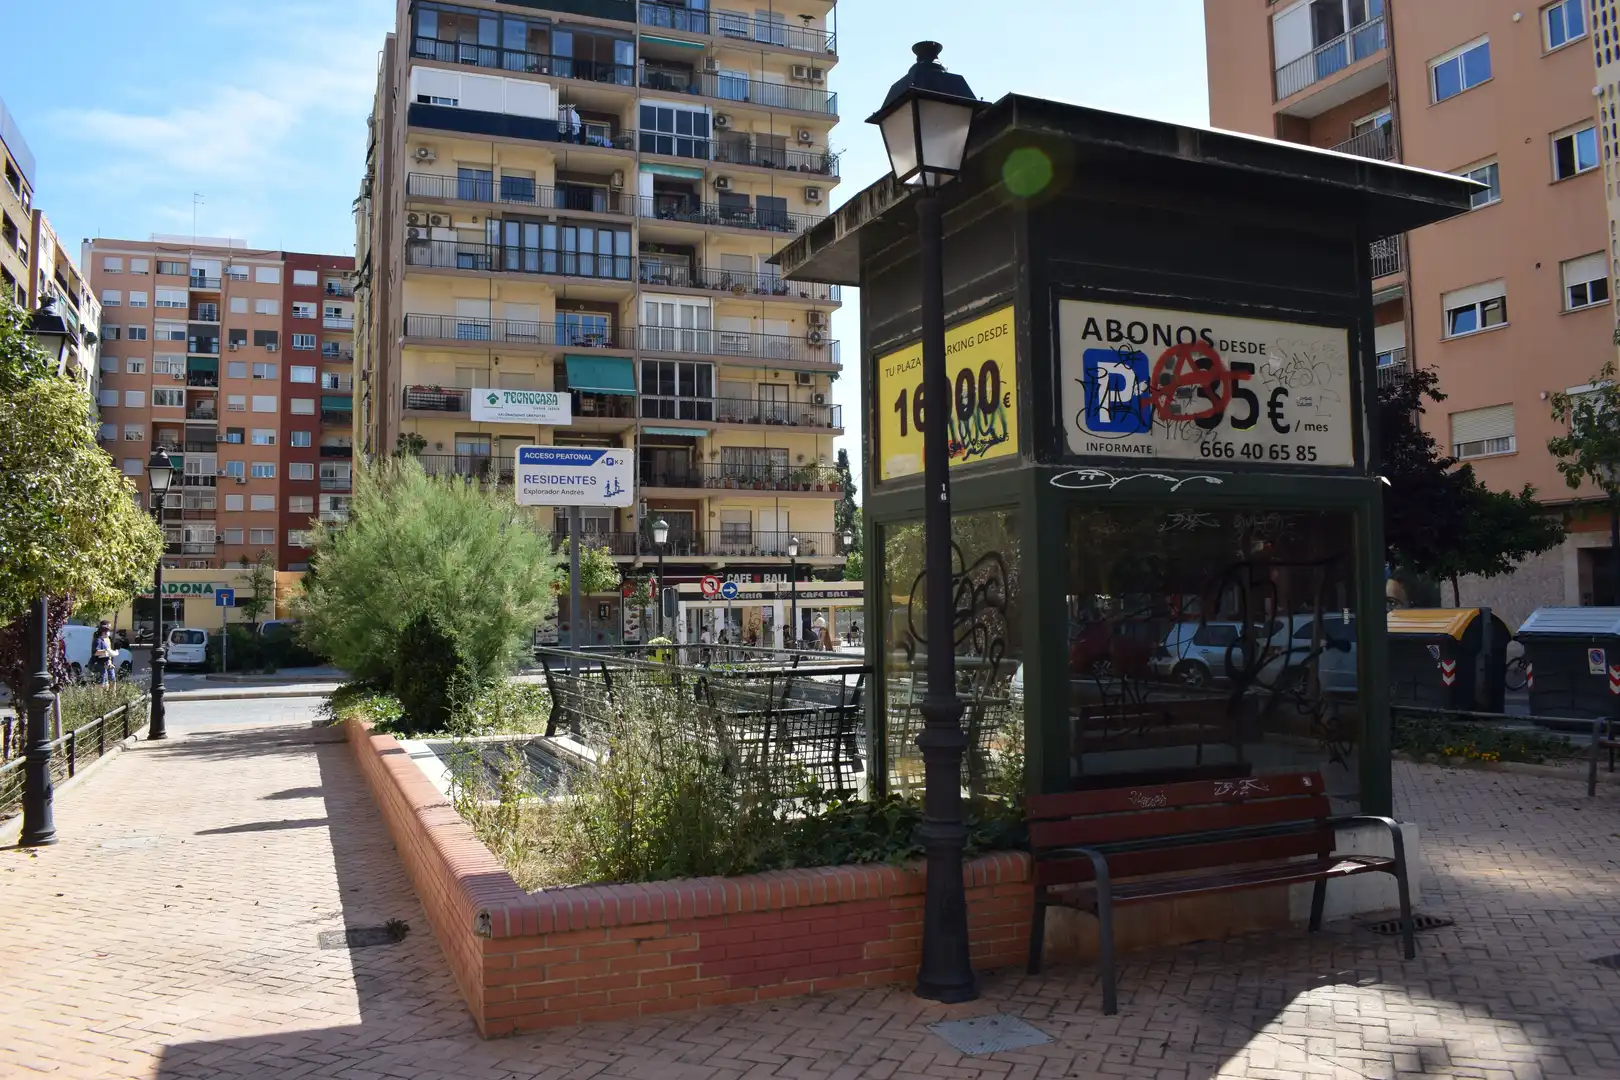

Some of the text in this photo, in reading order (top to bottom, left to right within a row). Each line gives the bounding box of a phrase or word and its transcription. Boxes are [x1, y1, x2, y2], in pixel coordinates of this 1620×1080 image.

[1081, 316, 1266, 355] ABONOS DESDE
[885, 367, 895, 378] TU
[897, 356, 922, 374] PLAZA
[977, 323, 1008, 344] DESDE
[503, 391, 558, 405] TECNOCASA
[1086, 442, 1153, 455] INFORMATE
[1200, 440, 1317, 461] 666 40 65 85
[524, 452, 593, 461] ACCESO PEATONAL
[523, 474, 597, 486] RESIDENTES
[523, 488, 584, 497] Explorador Andrés
[727, 573, 787, 583] CAFE BALI
